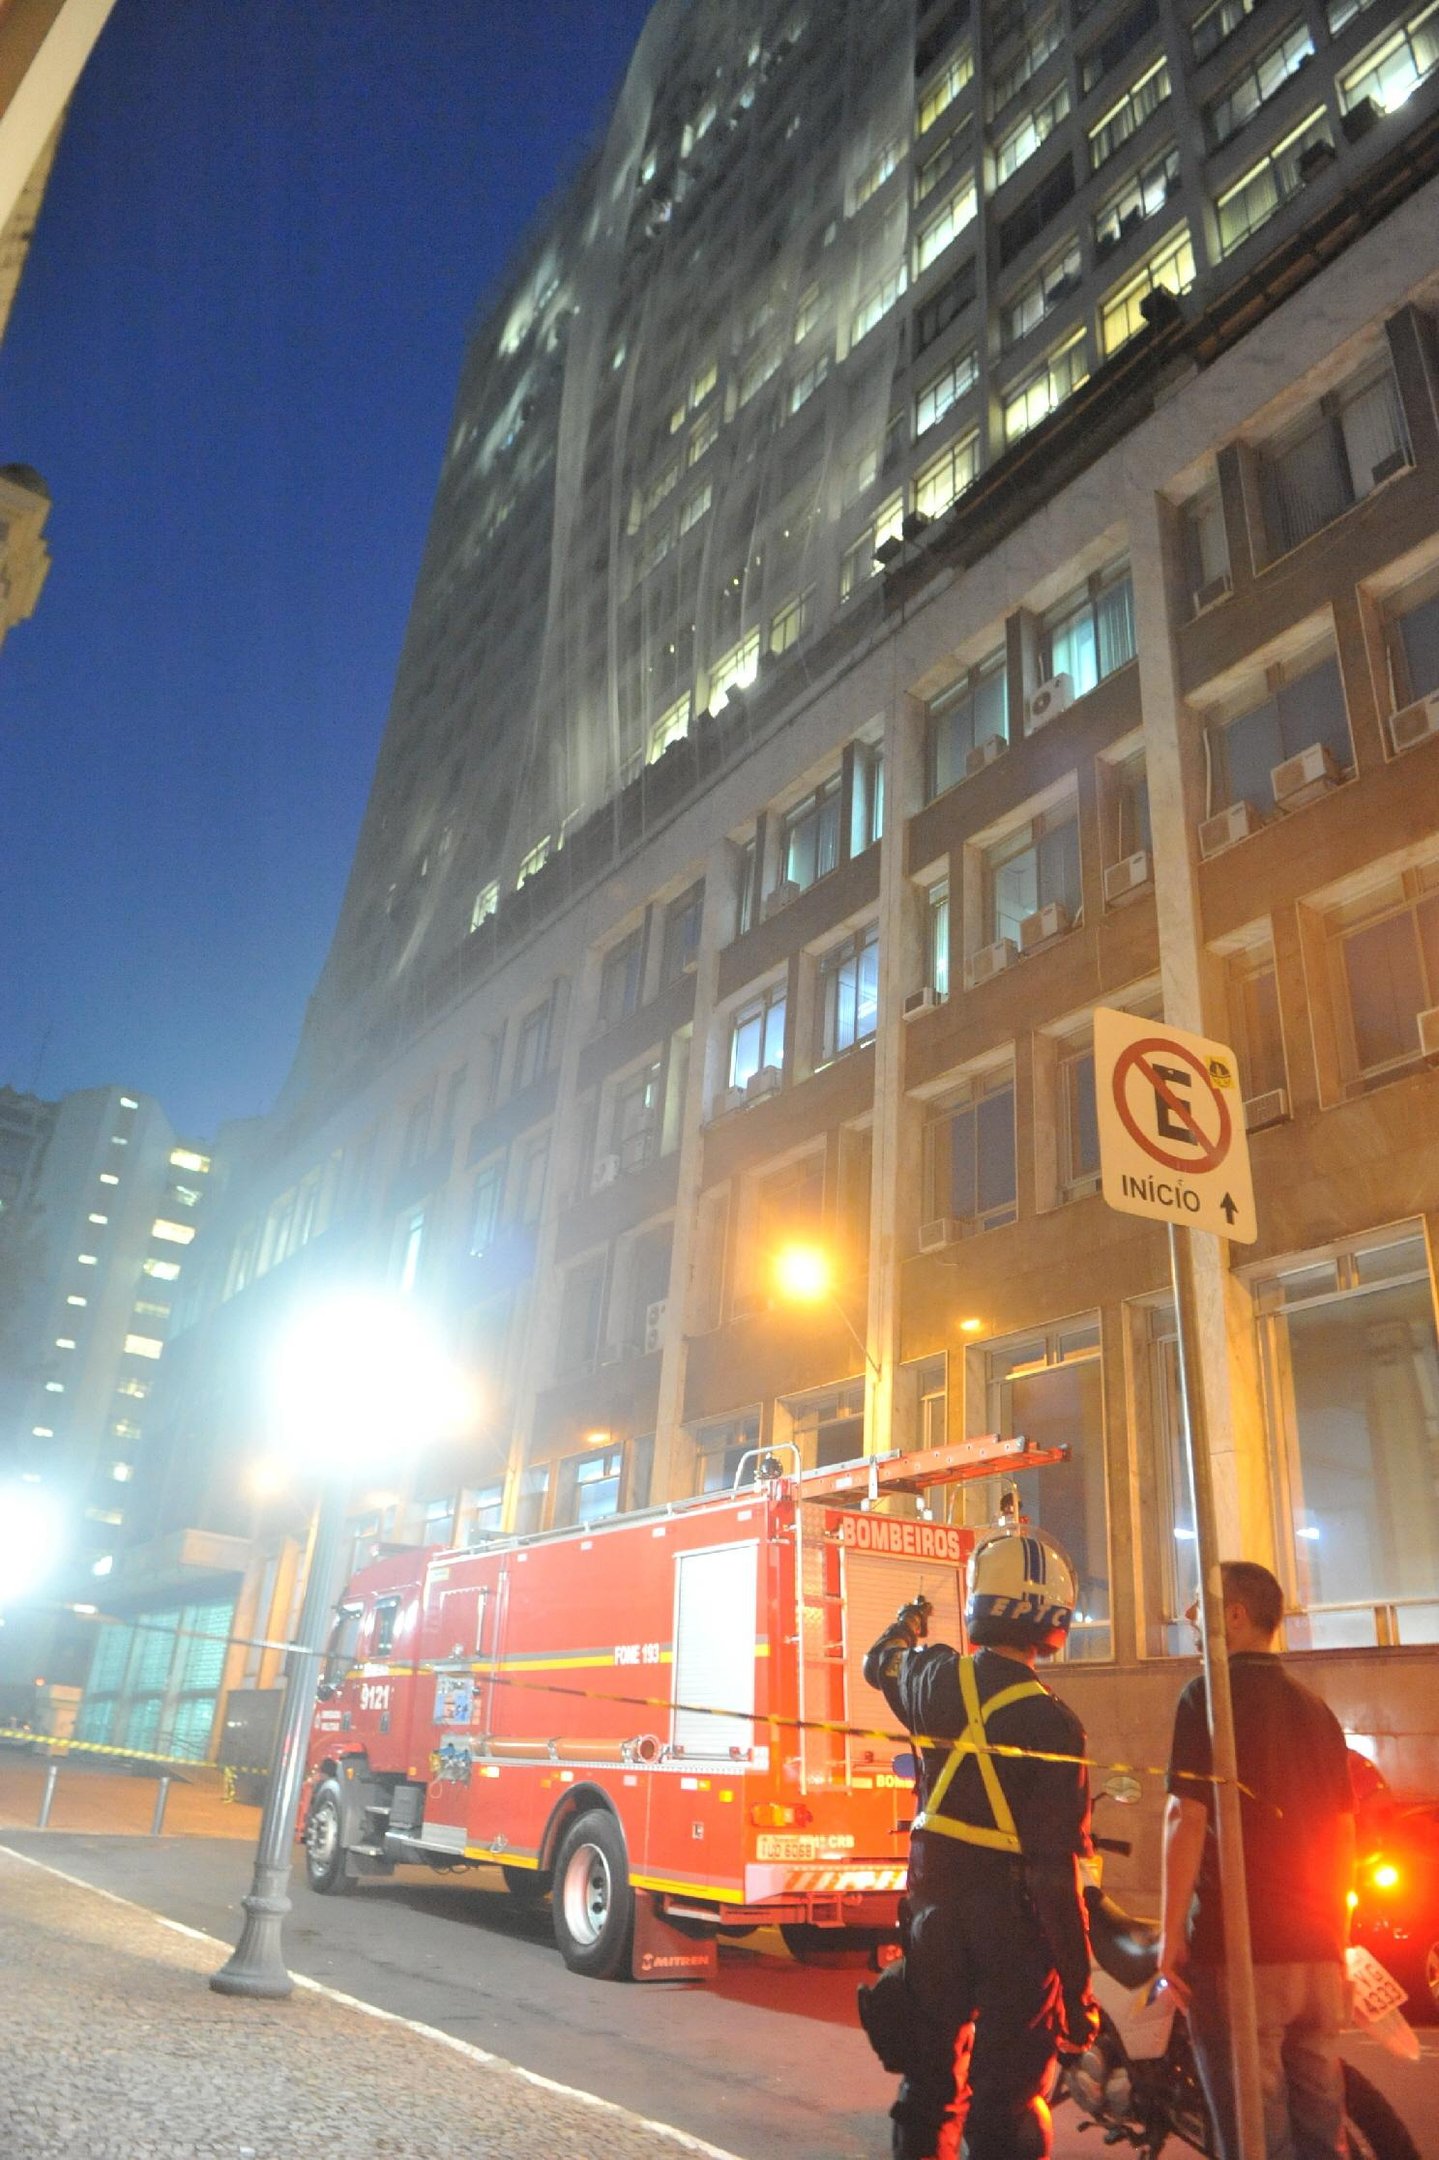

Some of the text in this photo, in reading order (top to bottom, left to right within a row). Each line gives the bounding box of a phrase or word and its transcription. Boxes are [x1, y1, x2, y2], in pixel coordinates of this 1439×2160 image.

[1122, 1174, 1200, 1213] INÍCIO
[842, 1516, 960, 1560] BOMBEIROS
[641, 1642, 660, 1664] 193
[360, 1683, 390, 1710] 9121
